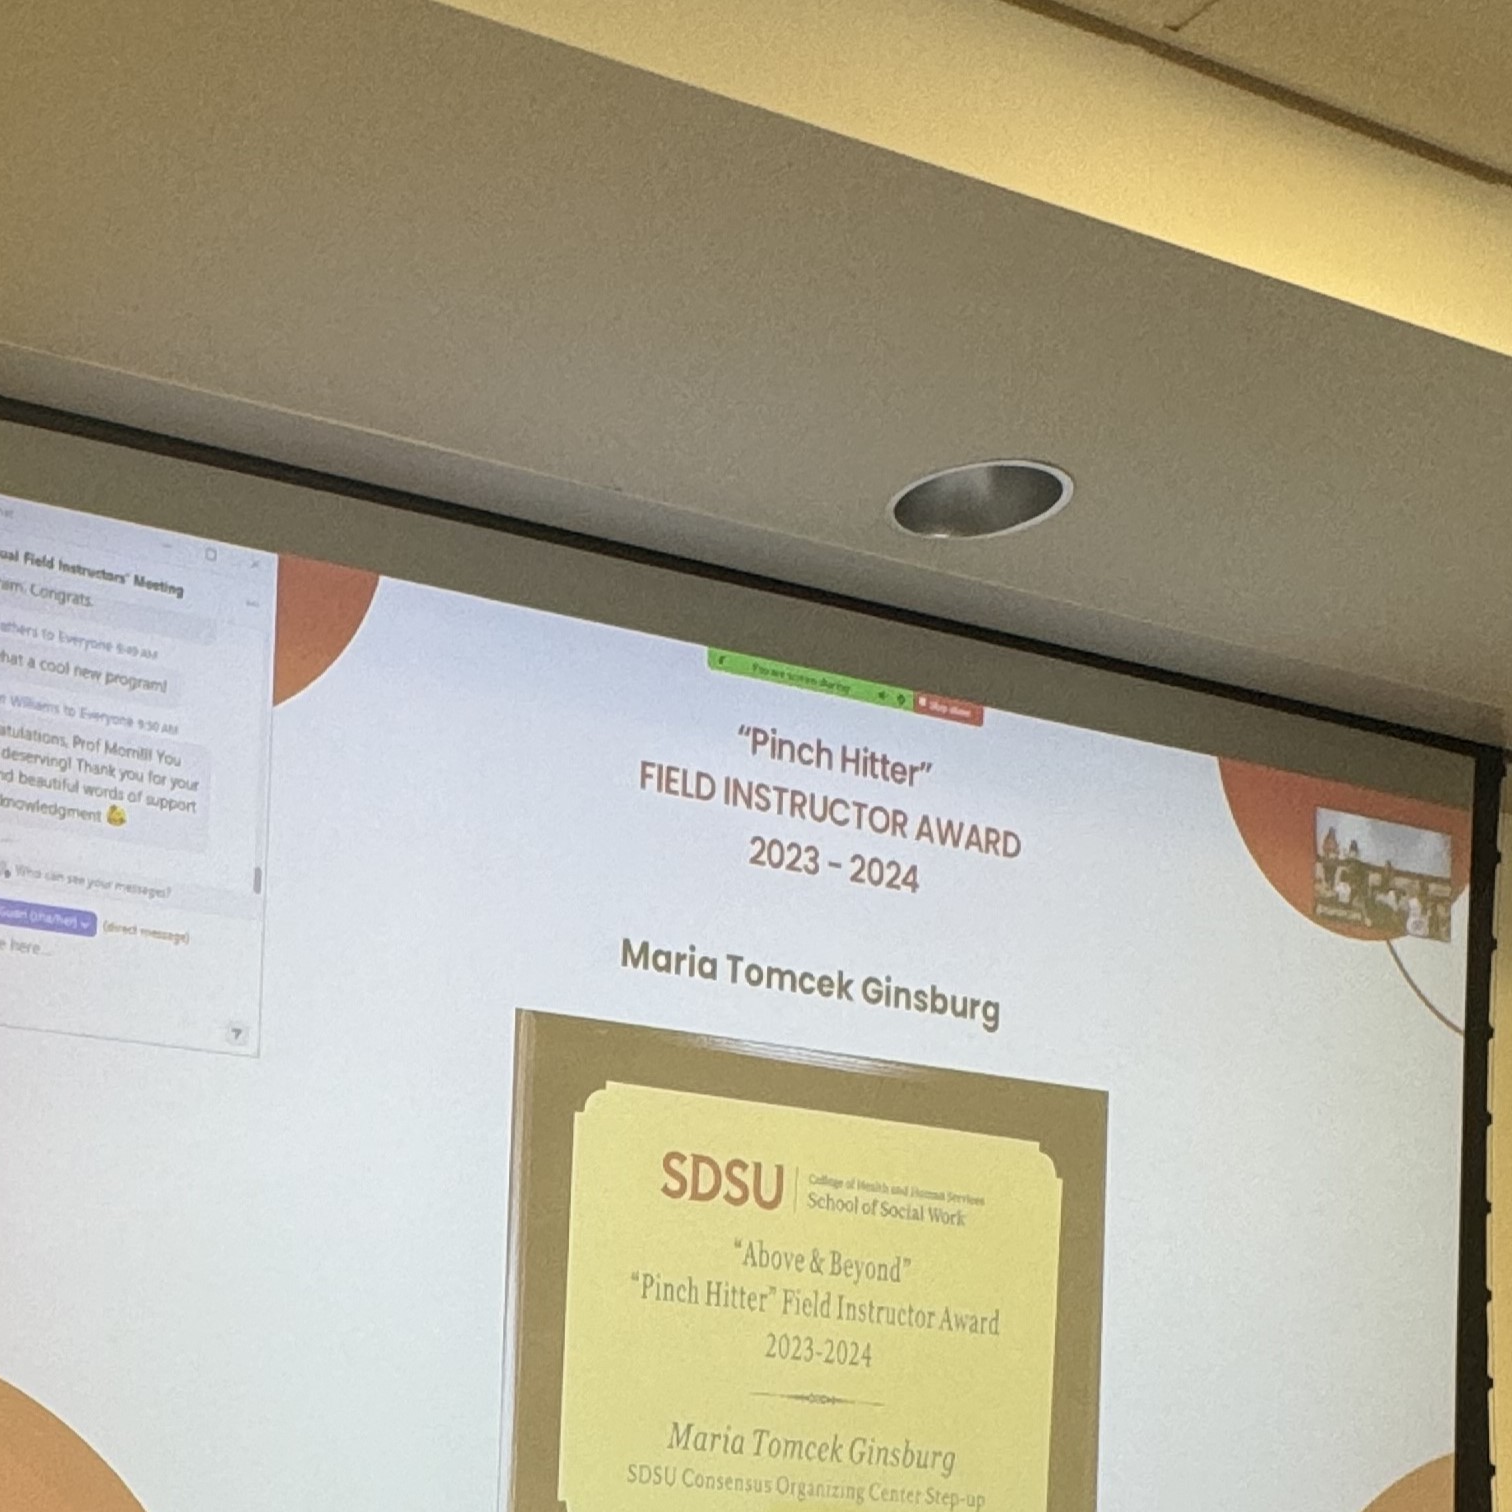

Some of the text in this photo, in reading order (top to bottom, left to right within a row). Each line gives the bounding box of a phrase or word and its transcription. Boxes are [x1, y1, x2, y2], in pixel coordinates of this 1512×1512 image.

[24, 551, 54, 570] Field
[134, 574, 185, 599] Meeting
[30, 583, 94, 608] Congrats.
[42, 628, 55, 641] to
[58, 630, 113, 651] Everyone
[140, 649, 159, 661] AM
[27, 658, 36, 669] a
[39, 658, 70, 675] cool
[74, 666, 101, 681] new
[105, 671, 168, 693] program!
[11, 694, 61, 714] Williams
[64, 704, 76, 718] to
[80, 708, 134, 728] Everyone
[162, 723, 179, 736] AM
[1, 747, 72, 773] deserving!
[77, 758, 116, 778] Thank
[119, 768, 144, 785] you
[148, 771, 167, 786] for
[170, 777, 200, 794] your
[73, 735, 100, 753] Prof
[157, 750, 182, 768] You
[737, 723, 933, 788] “Pinch Hitter”
[18, 771, 79, 793] beautiful
[83, 782, 124, 800] words
[127, 790, 143, 805] of
[146, 795, 198, 814] support
[639, 759, 1023, 860] FIELD INSTRUCTOR AWARD
[15, 863, 172, 900] Who can see your messages?
[748, 834, 821, 877] 2023
[848, 853, 921, 894] 2024
[103, 920, 190, 946] (direct message)
[620, 936, 1001, 1033] Maria Tomcek Ginsburg
[660, 1150, 785, 1211] SDSU
[846, 1179, 856, 1190] of
[857, 1179, 889, 1194] Health
[891, 1185, 909, 1197] and
[946, 1191, 985, 1206] Services
[807, 1191, 967, 1227] School of Social Work
[734, 1238, 912, 1284] “Above & Beyond”
[631, 1270, 1000, 1336] “Pinch Hitter” Field Instructor Award
[764, 1332, 873, 1368] 2023-2024
[667, 1421, 957, 1478] Maria Tomcek Ginsburg
[626, 1463, 986, 1512] SDSU Consensus Organizing Center Step-up
